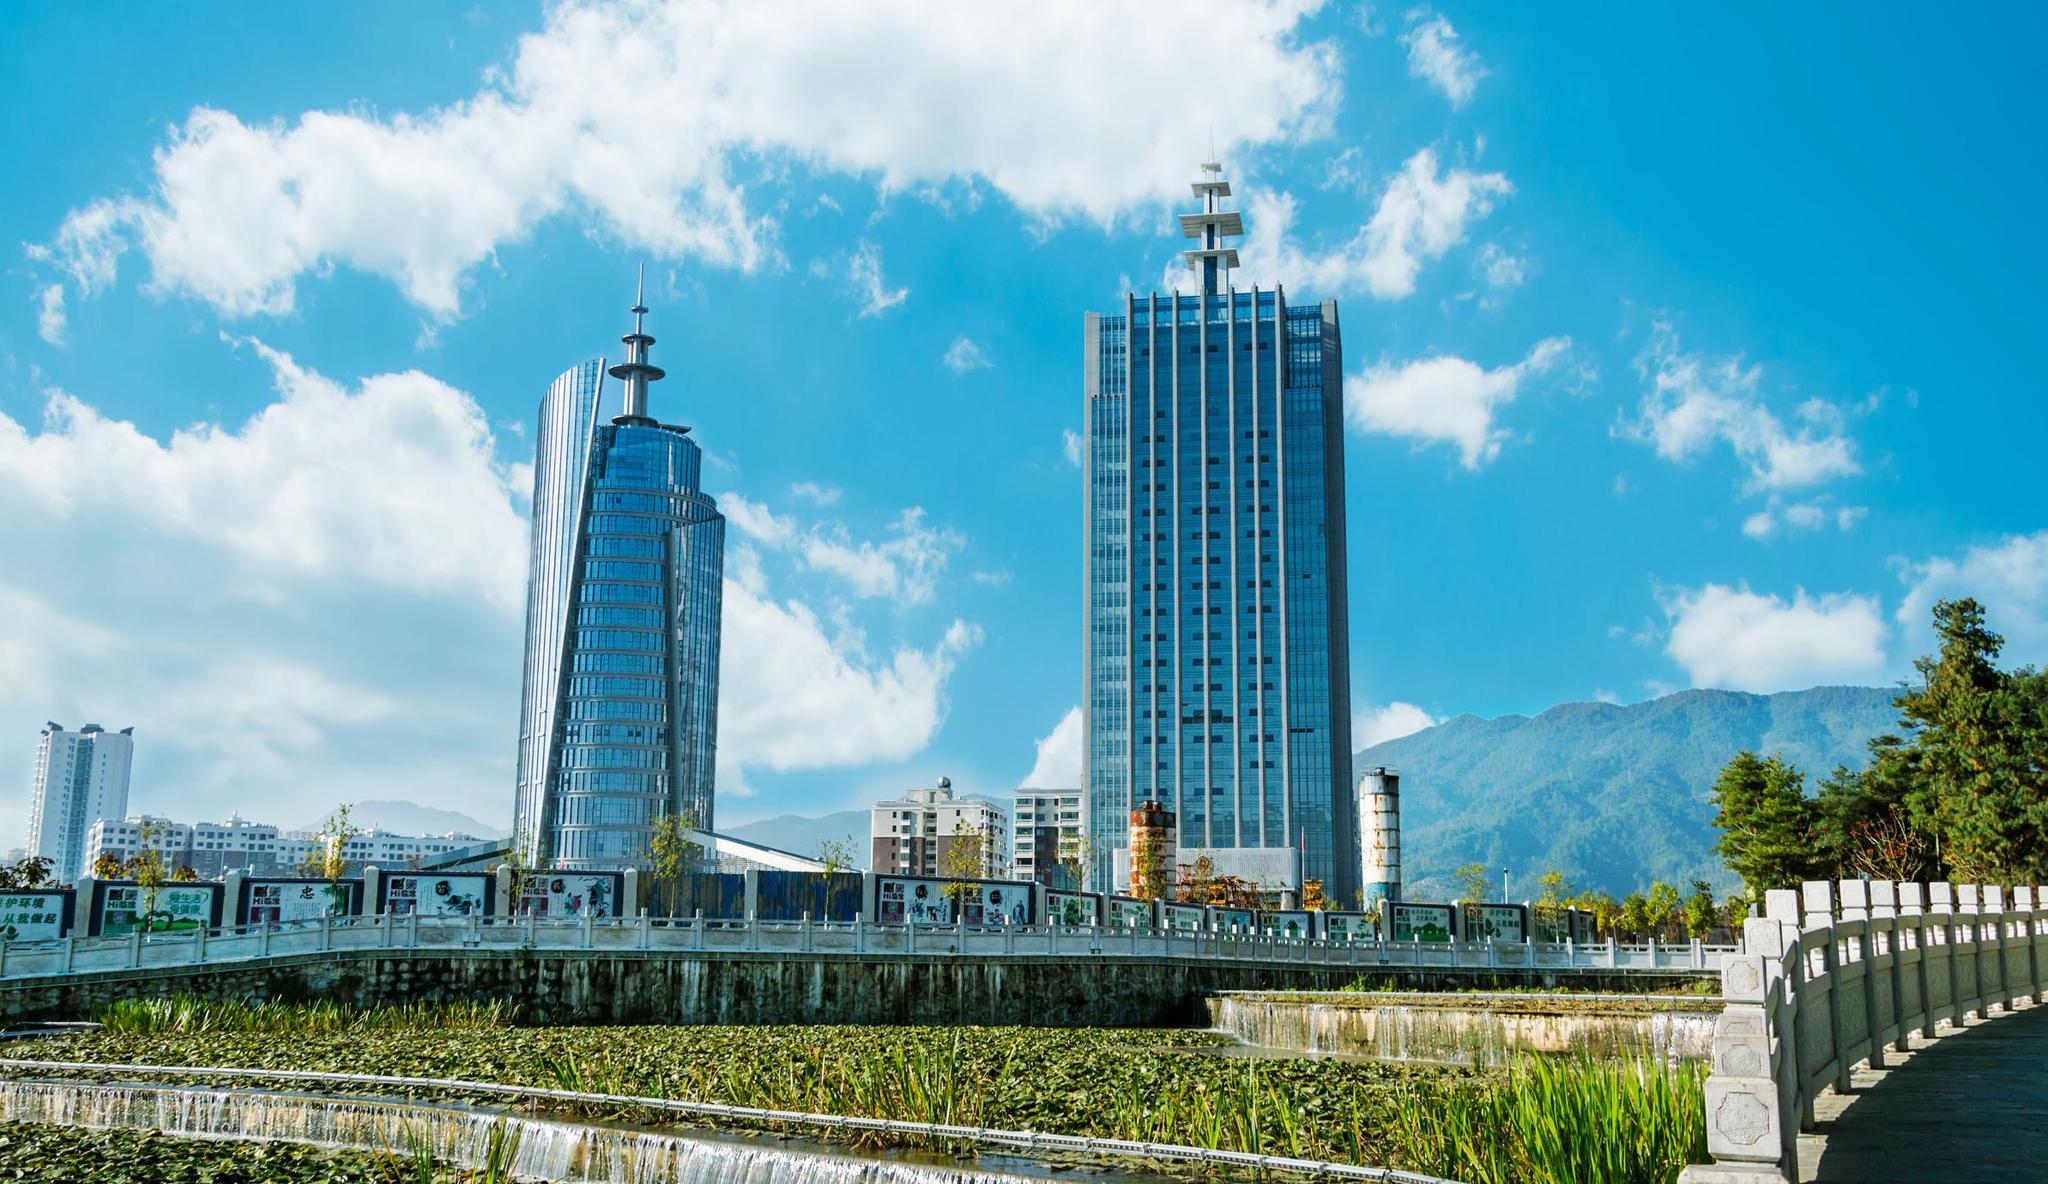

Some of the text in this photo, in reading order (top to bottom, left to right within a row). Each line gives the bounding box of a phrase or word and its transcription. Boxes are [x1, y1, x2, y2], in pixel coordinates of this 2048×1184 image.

[299, 885, 315, 899] 忠
[0, 897, 45, 909] 护环境
